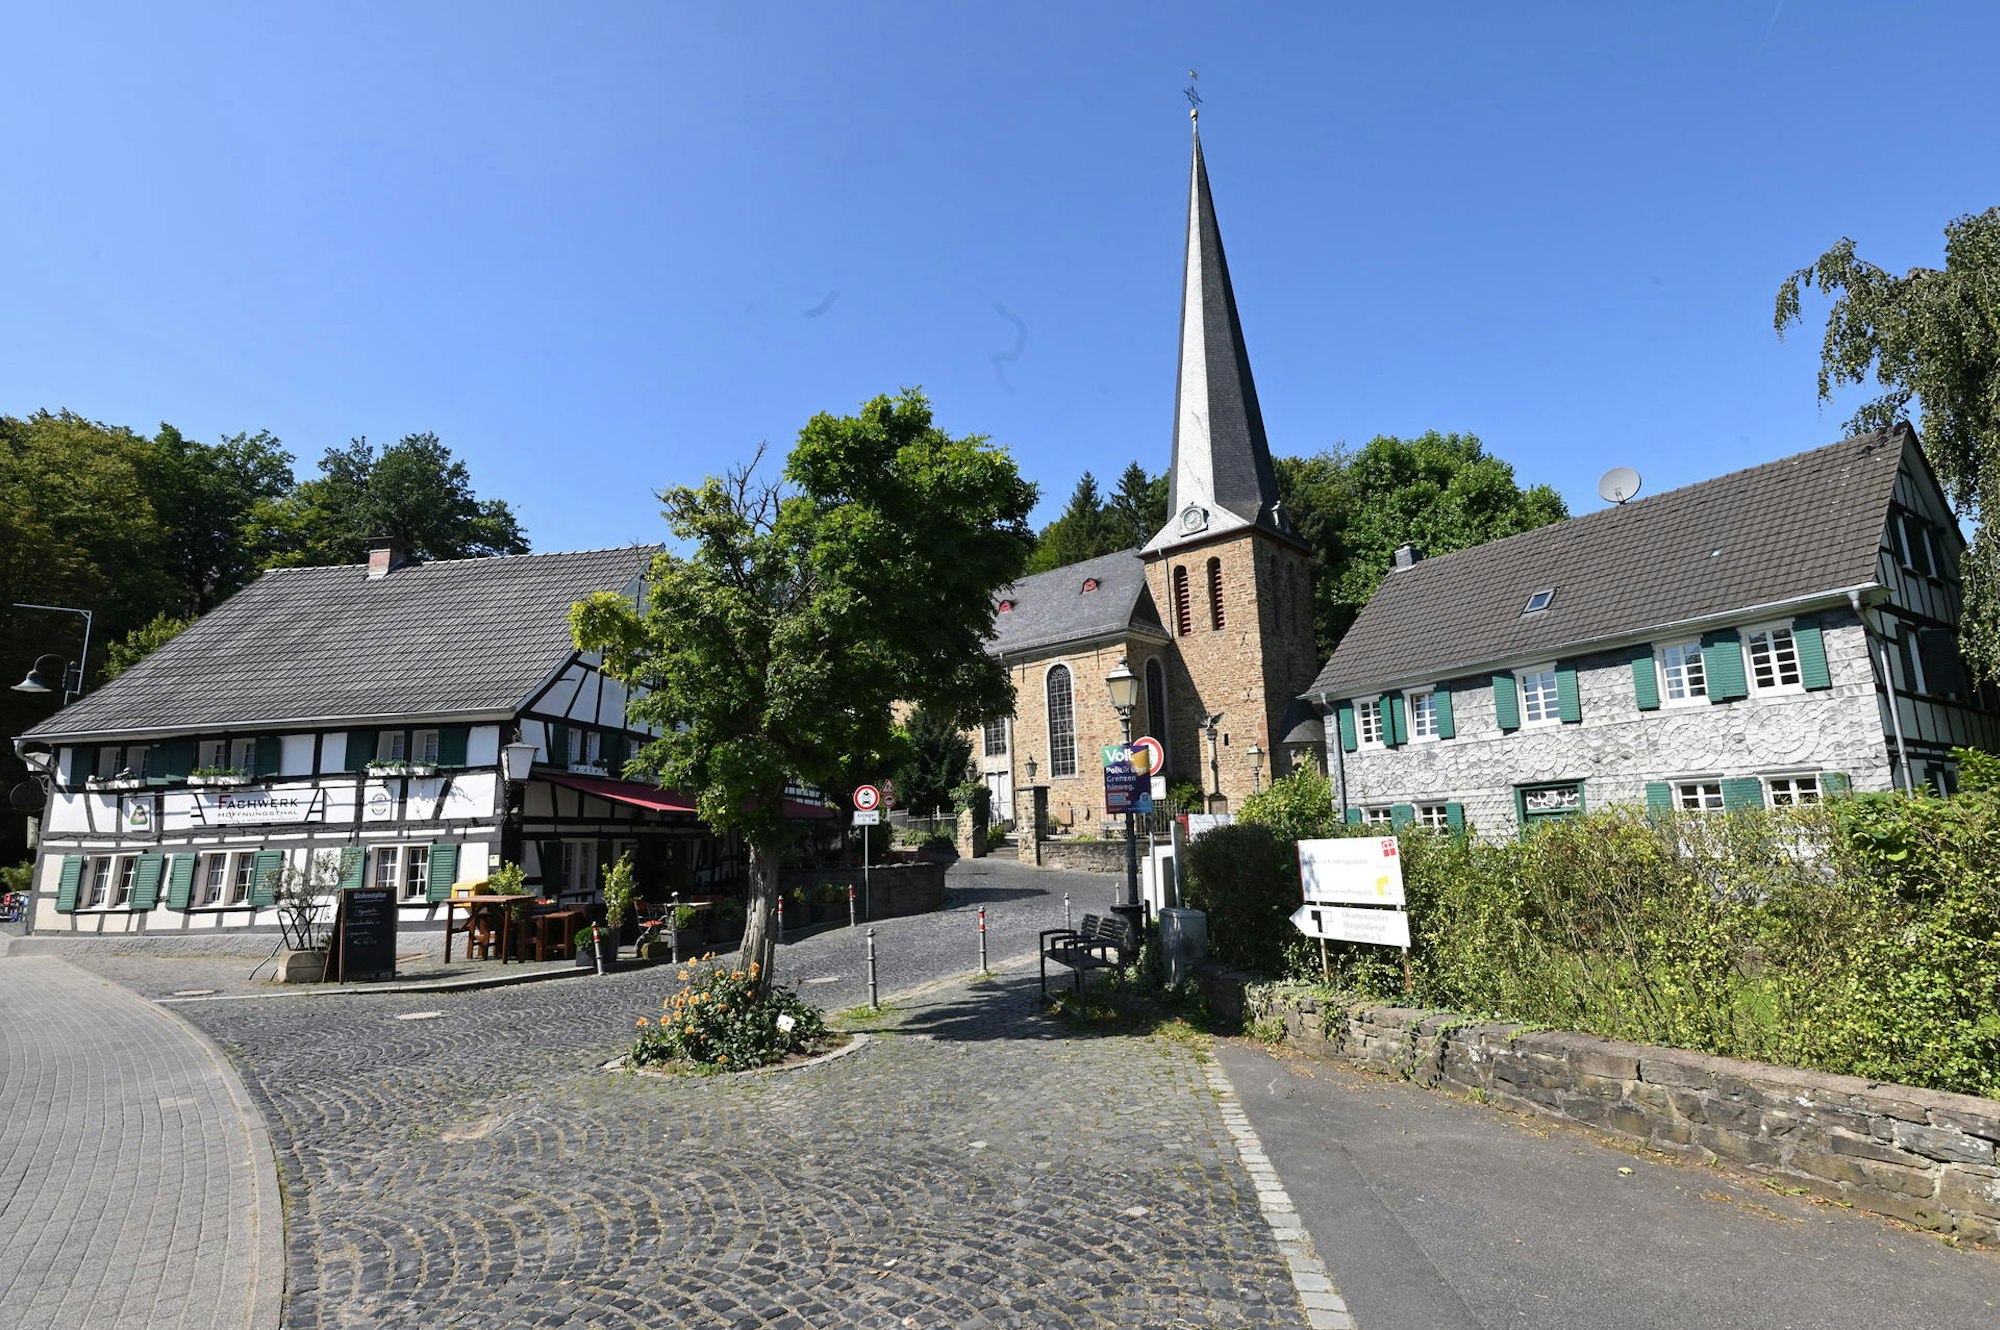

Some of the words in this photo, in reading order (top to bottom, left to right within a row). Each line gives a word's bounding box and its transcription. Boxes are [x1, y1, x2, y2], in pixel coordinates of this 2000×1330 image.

[1105, 748, 1135, 762] Volt
[1106, 766, 1130, 774] Politik
[1107, 775, 1137, 783] Grenzen
[1107, 784, 1136, 792] hinweg.
[218, 794, 299, 809] FACHWERK
[217, 810, 299, 818] HOFFNUNGSTHAL
